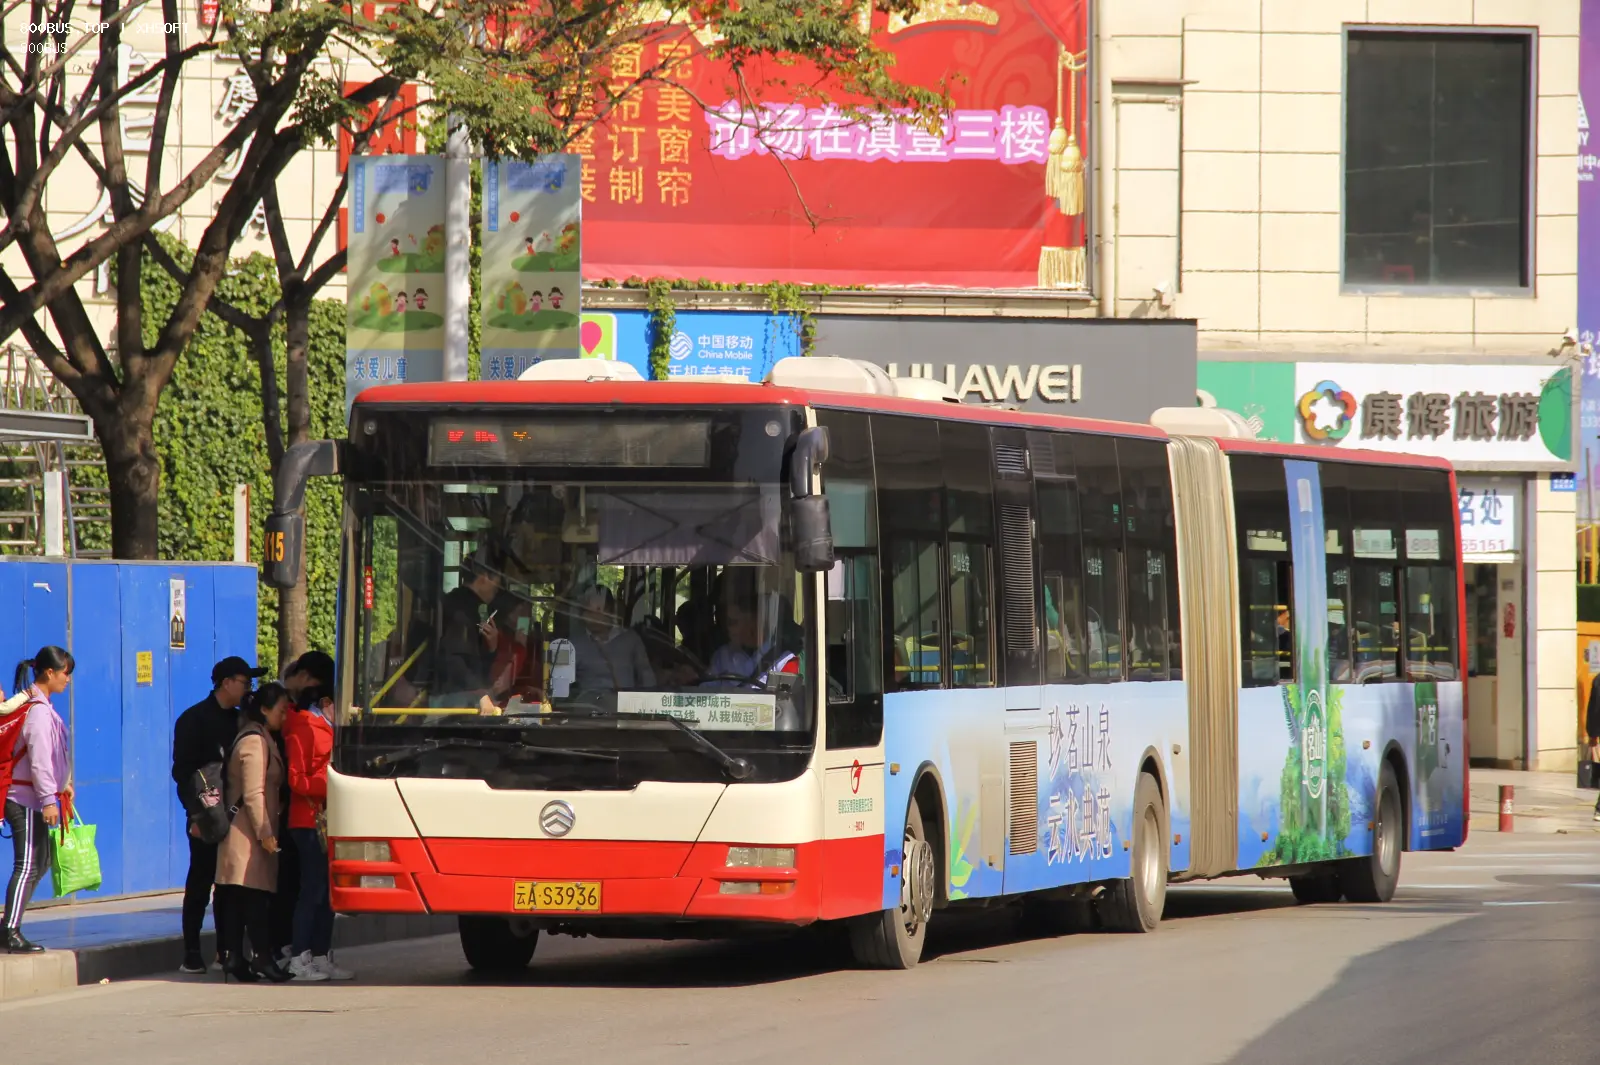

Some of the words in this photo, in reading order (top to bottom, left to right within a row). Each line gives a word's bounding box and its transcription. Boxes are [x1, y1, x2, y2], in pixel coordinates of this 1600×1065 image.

[608, 42, 645, 204] 窗帘订制
[656, 40, 692, 207] 完美窗帘
[708, 105, 1046, 159] 市场在滇壹三楼
[697, 334, 753, 349] 中国移动
[697, 350, 723, 360] China
[724, 351, 753, 360] Mobile
[354, 356, 408, 380] 关爱儿童
[489, 355, 543, 380] 关爱儿
[1361, 391, 1541, 441] 康辉旅游
[661, 694, 731, 708] 创建文明城市
[1048, 702, 1113, 781] 珍茗山泉
